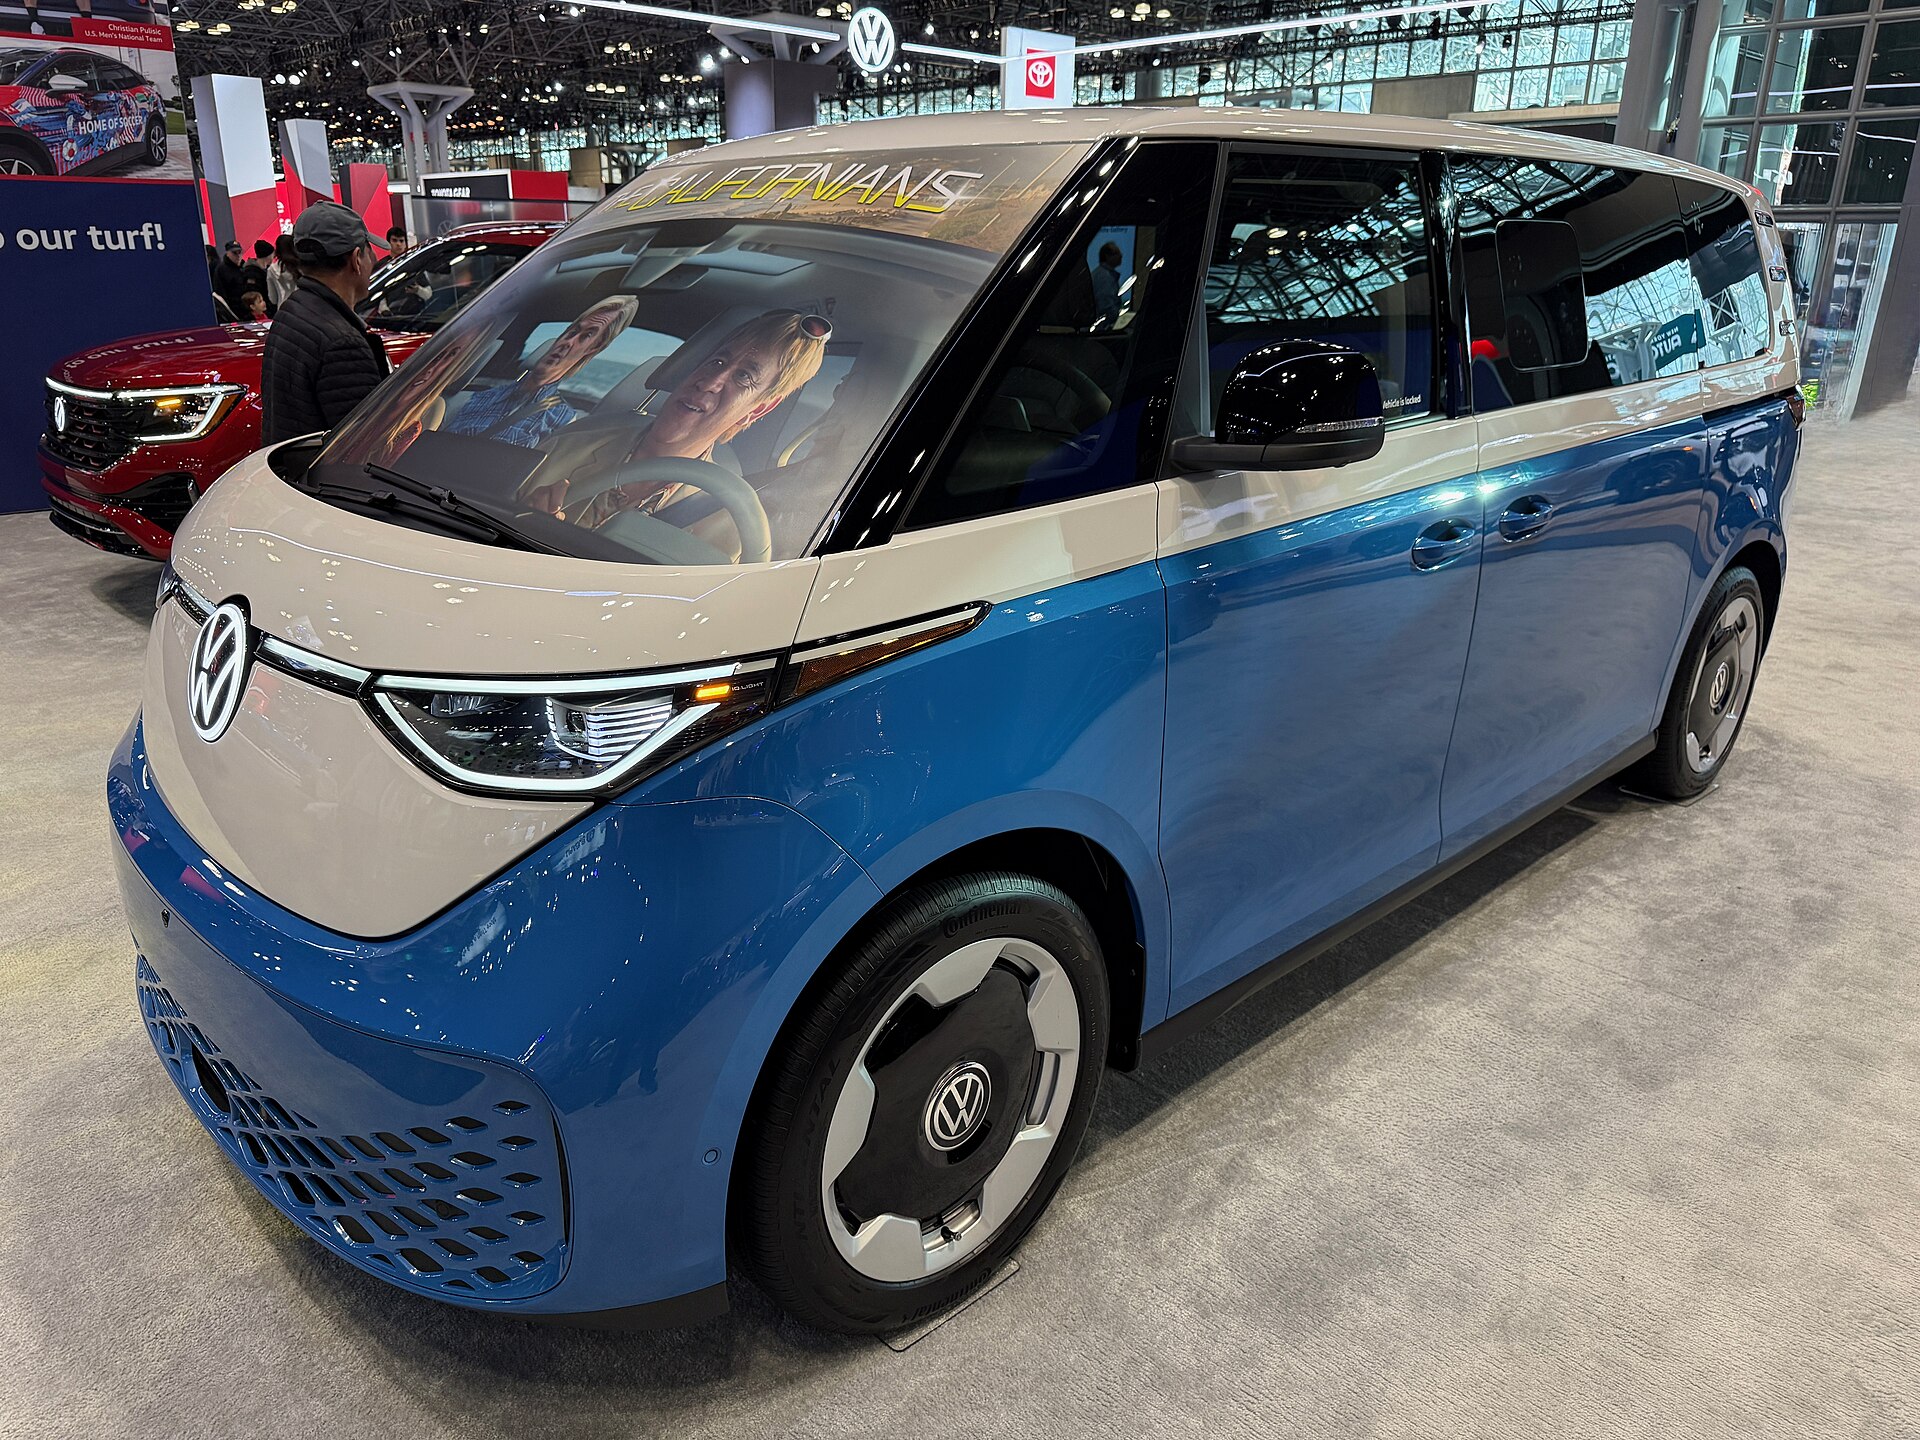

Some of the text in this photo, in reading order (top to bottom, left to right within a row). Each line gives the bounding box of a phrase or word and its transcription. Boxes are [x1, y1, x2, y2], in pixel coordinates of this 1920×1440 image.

[84, 29, 98, 37] U.S.
[98, 31, 118, 39] Men's
[118, 33, 145, 42] National
[108, 23, 162, 36] Christian Pulisic
[78, 115, 143, 135] HOME OF SOCCER
[626, 163, 984, 213] CALIFORNIANS
[16, 228, 77, 251] our
[86, 222, 166, 251] turf!
[188, 603, 246, 743] VW
[942, 899, 1023, 938] Continental
[927, 1064, 989, 1148] VW
